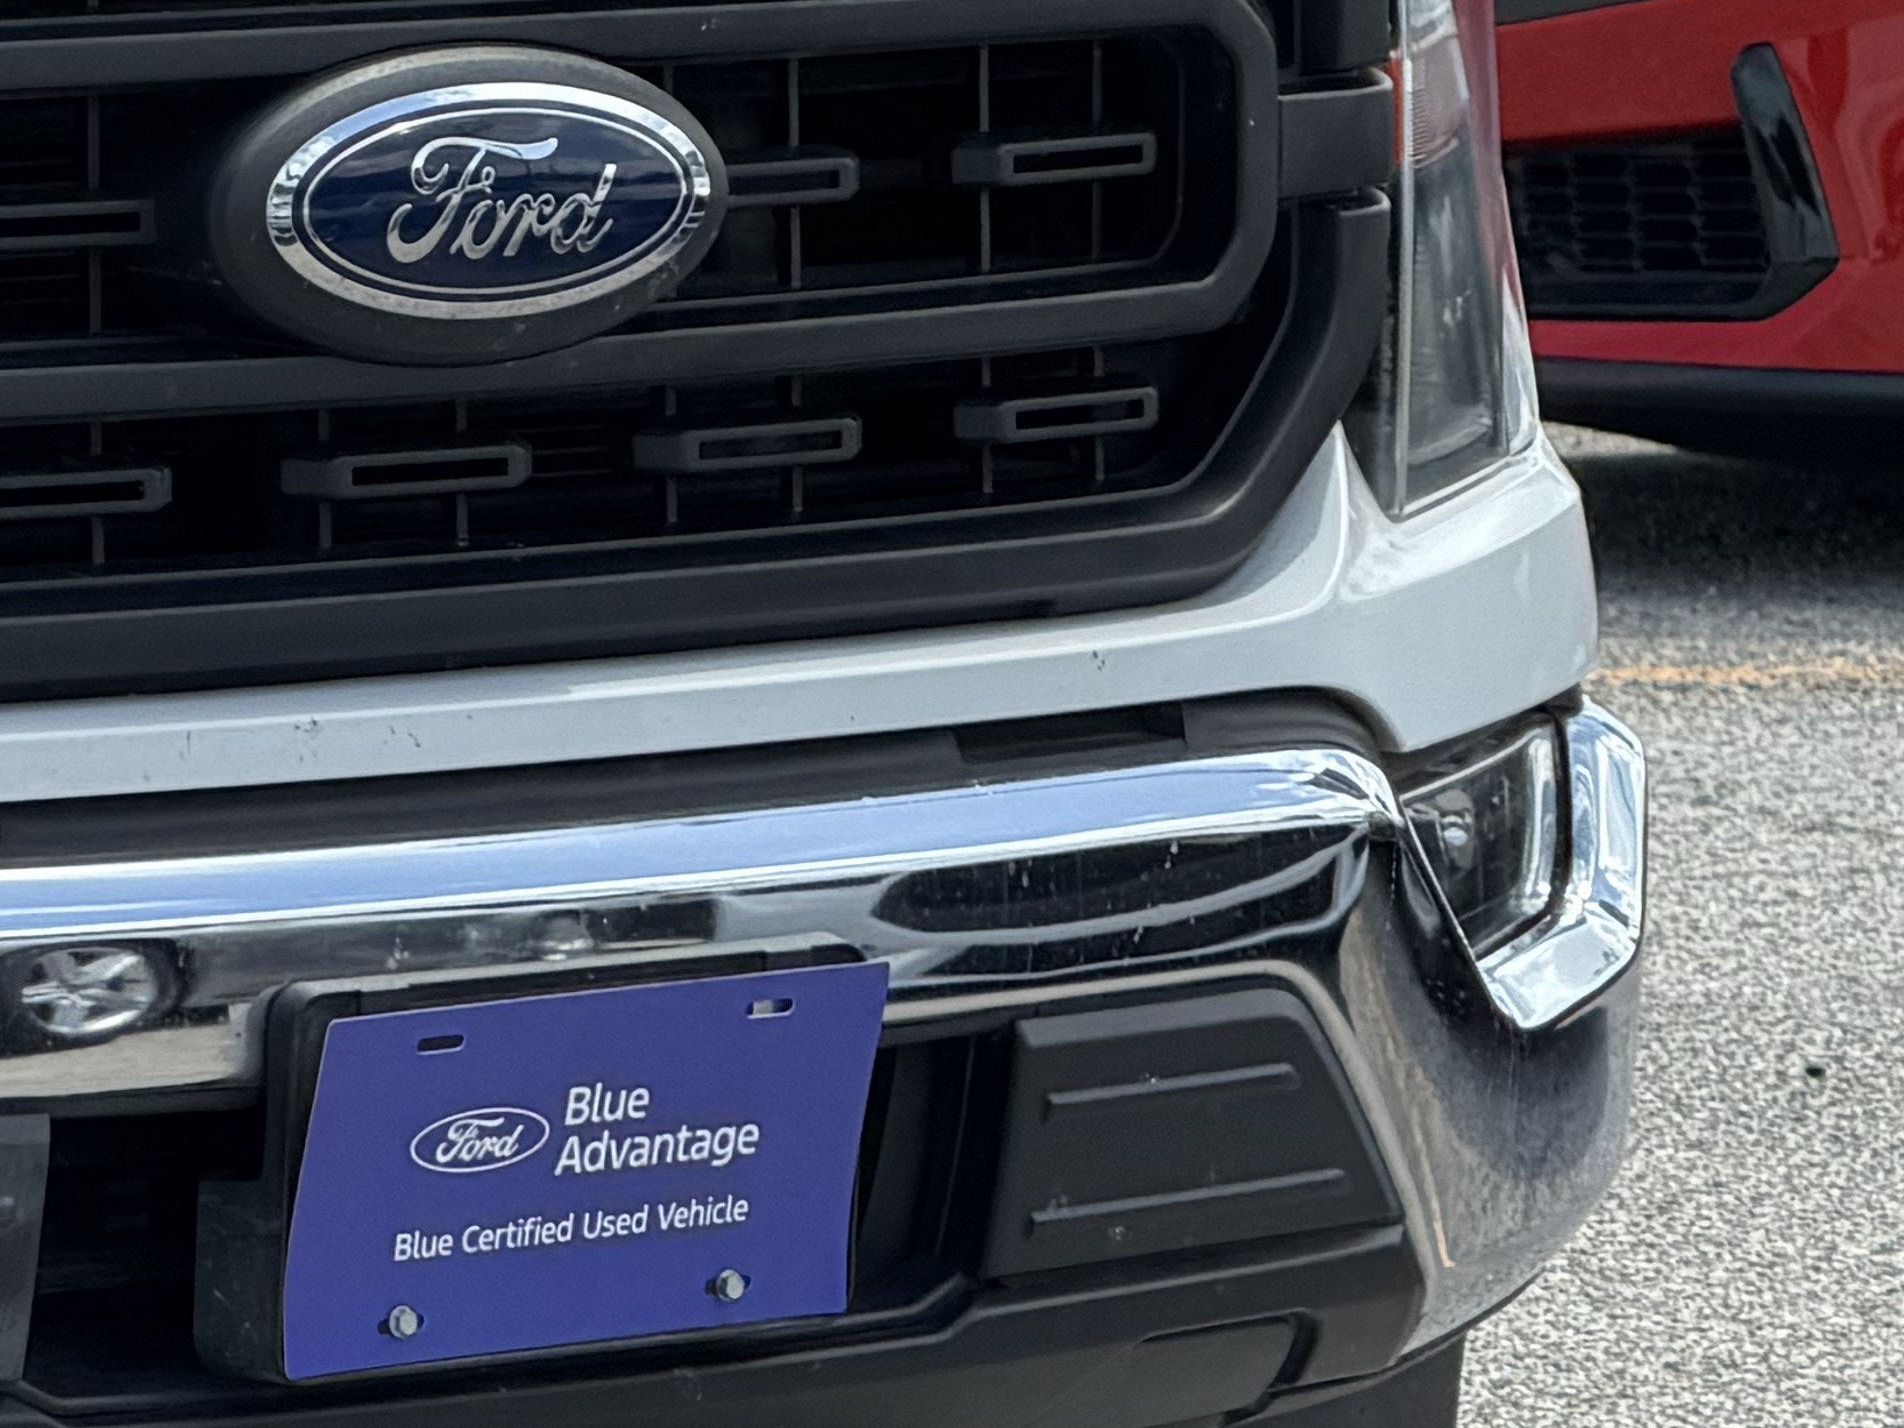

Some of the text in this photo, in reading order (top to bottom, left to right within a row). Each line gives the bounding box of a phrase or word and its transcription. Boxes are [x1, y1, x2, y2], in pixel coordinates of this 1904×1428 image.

[386, 135, 616, 265] Ford
[564, 1081, 650, 1126] Blue
[435, 1117, 525, 1164] Ford
[553, 1123, 760, 1177] Advantage
[393, 1194, 749, 1262] Blue Certified Used Vehicle
